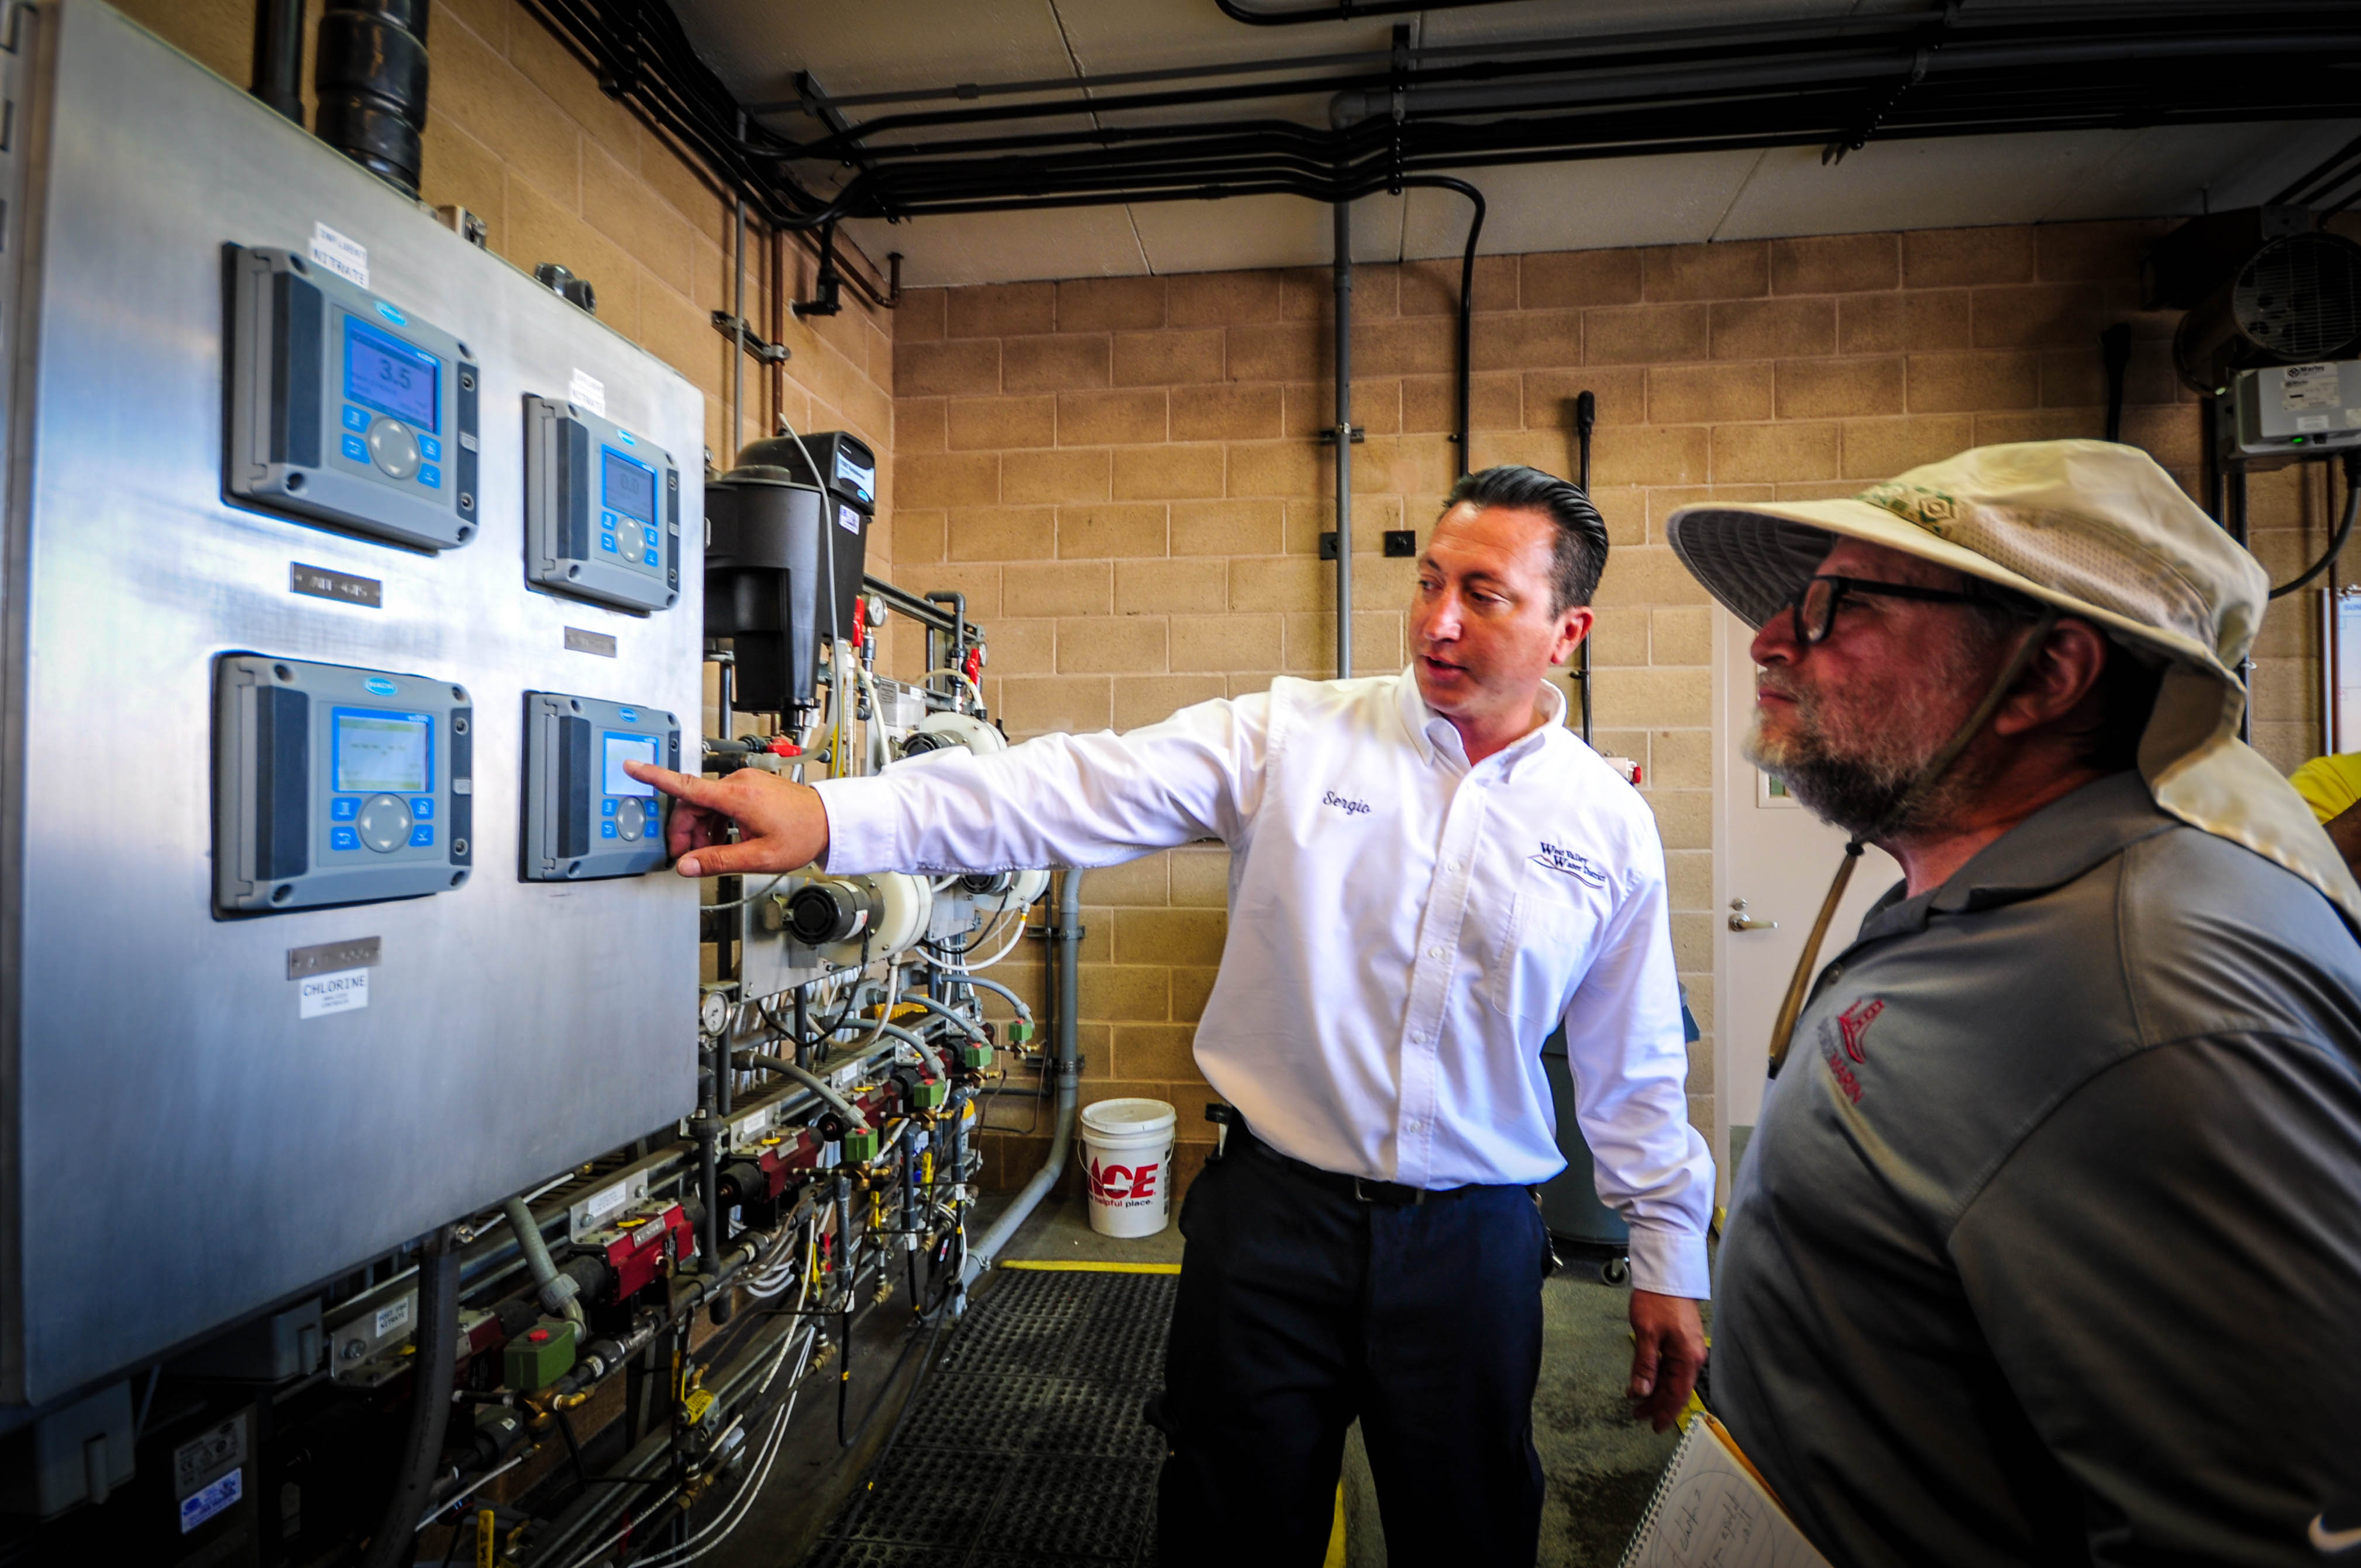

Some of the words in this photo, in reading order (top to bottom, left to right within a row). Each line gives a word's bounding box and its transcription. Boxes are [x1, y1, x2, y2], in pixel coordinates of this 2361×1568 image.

[314, 248, 364, 285] NITRATE
[380, 359, 411, 390] 3.5
[573, 390, 603, 413] NITRATE
[1323, 791, 1370, 815] Sergio
[1540, 842, 1565, 856] West
[1566, 850, 1588, 866] Valley
[1554, 855, 1581, 871] Water
[304, 975, 366, 996] CHLORINE
[1088, 1157, 1159, 1199] ACE
